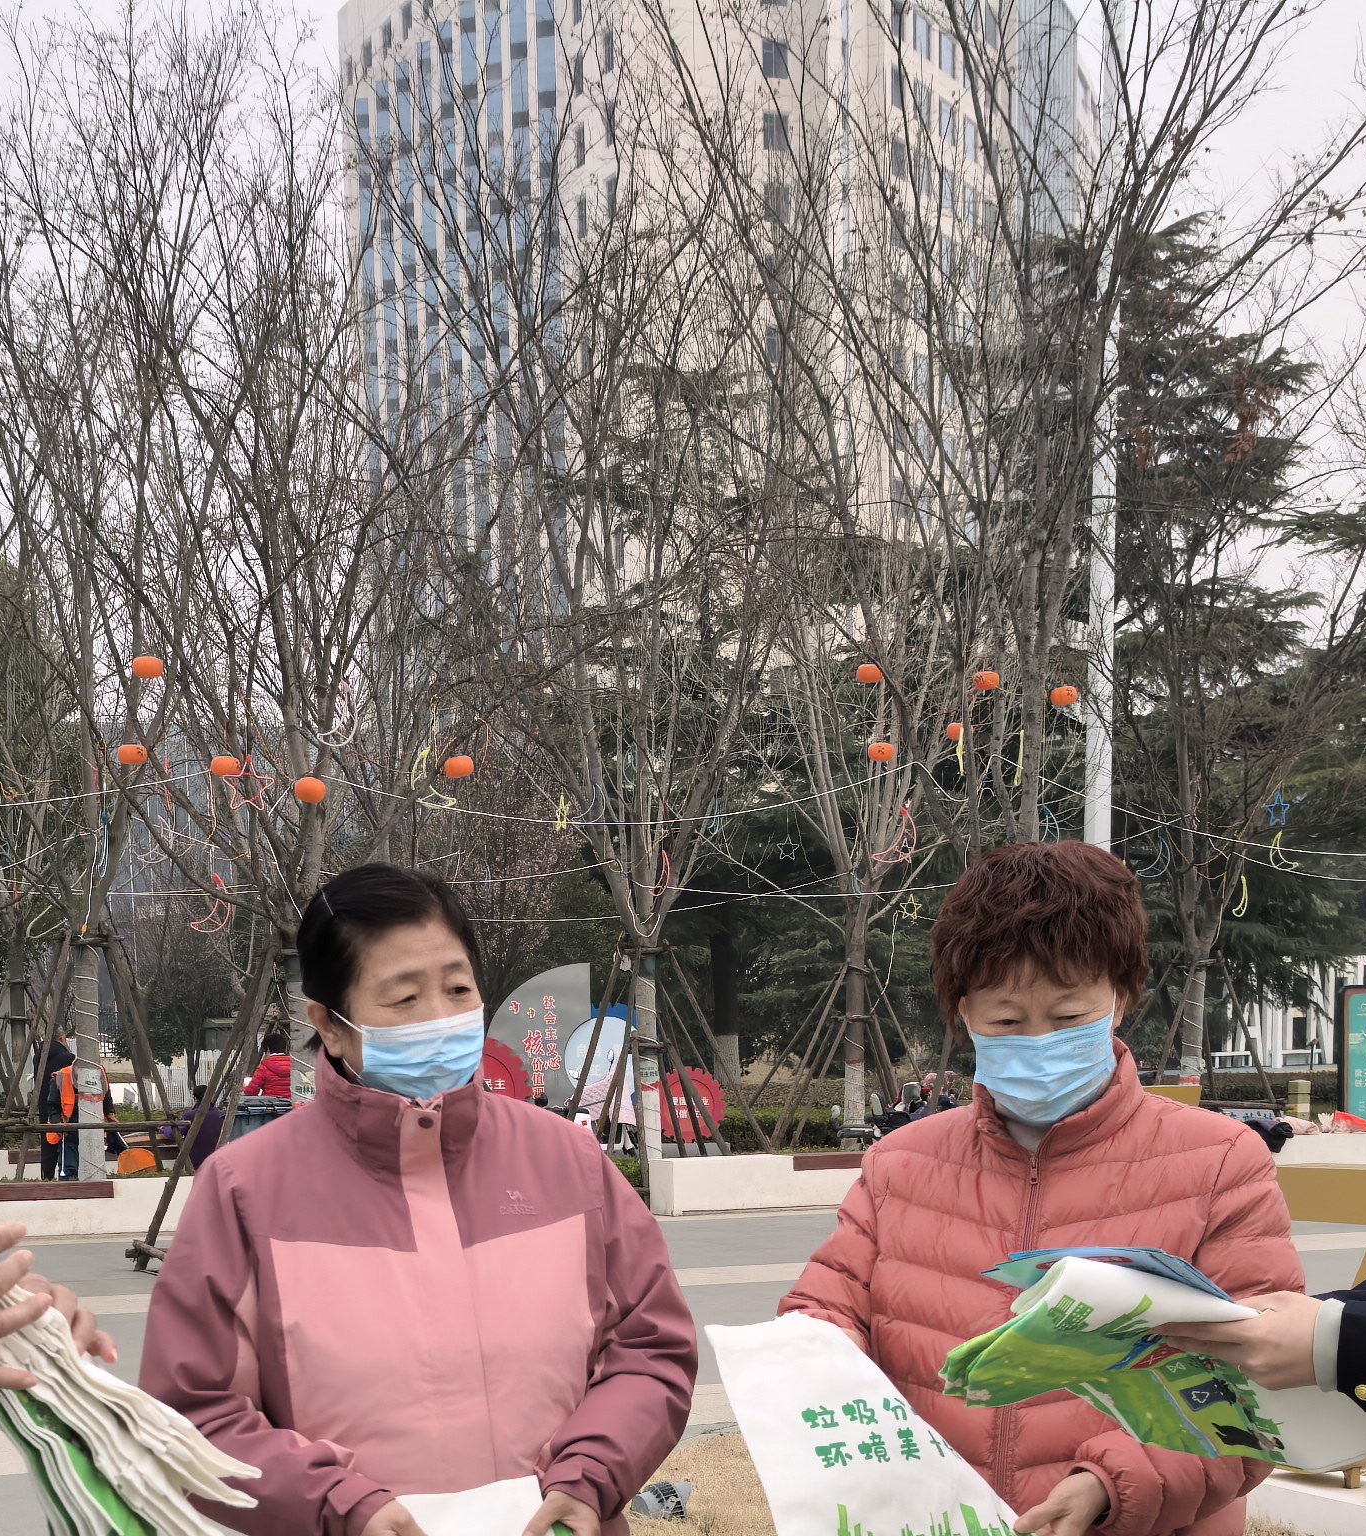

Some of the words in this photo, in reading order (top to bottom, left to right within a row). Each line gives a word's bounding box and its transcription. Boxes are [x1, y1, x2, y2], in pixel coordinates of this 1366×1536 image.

[543, 995, 559, 1056] 社会主义
[801, 1397, 920, 1429] 垃圾分
